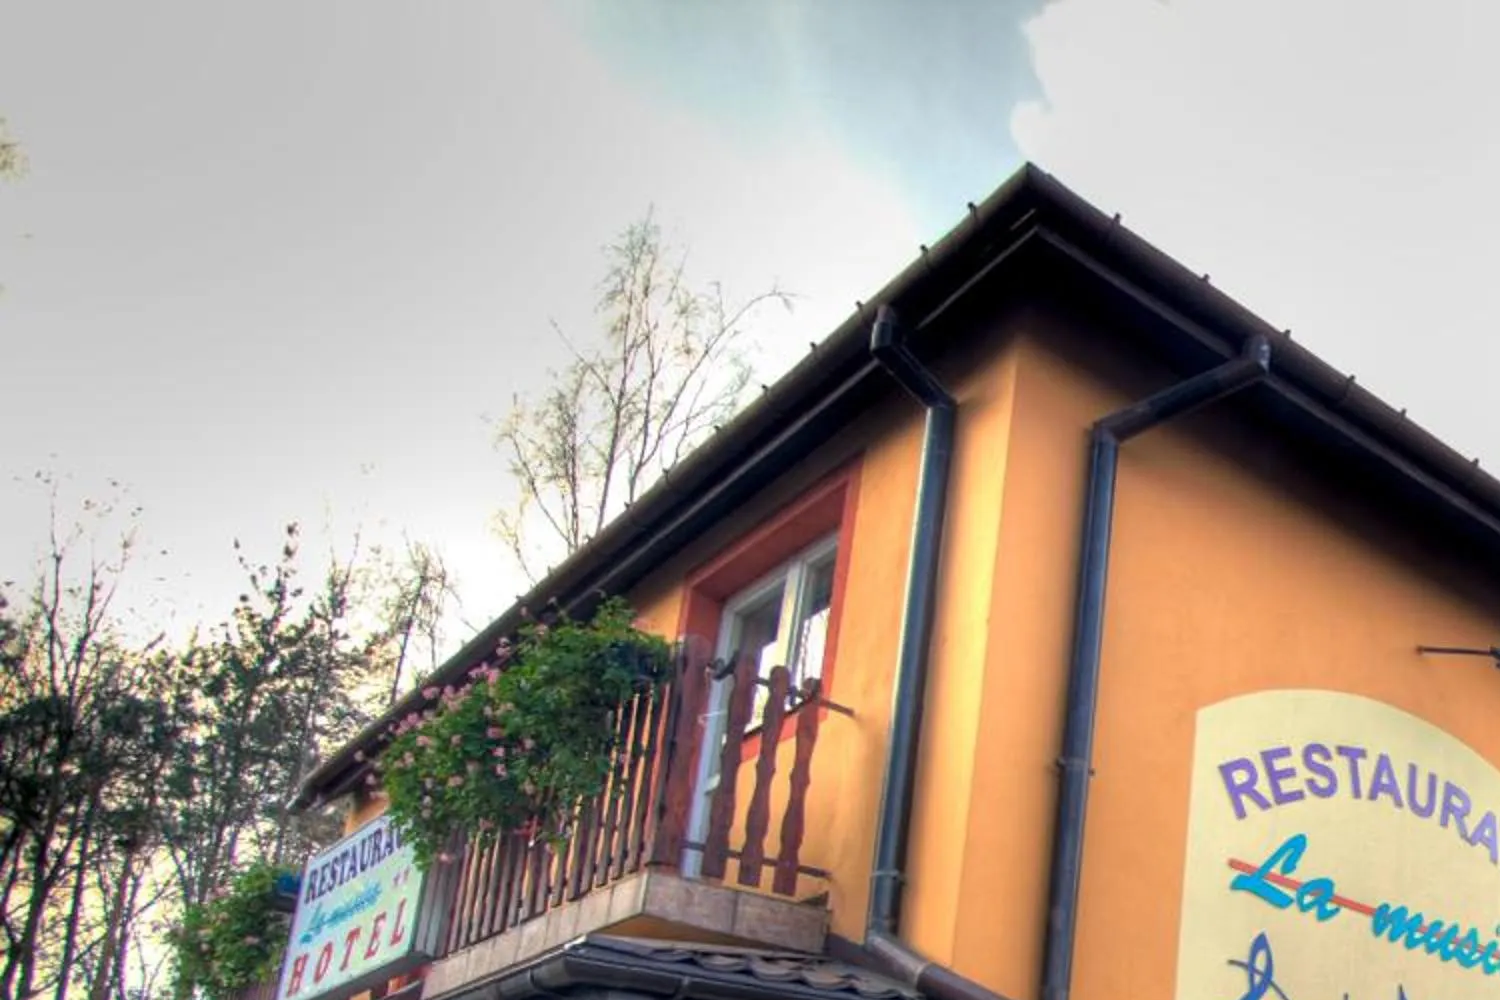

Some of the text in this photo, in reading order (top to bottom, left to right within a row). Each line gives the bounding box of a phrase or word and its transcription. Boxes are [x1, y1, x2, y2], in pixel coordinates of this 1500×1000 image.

[303, 827, 405, 904] RESTAURA
[1230, 833, 1341, 921] La
[286, 897, 407, 998] HOTEL
